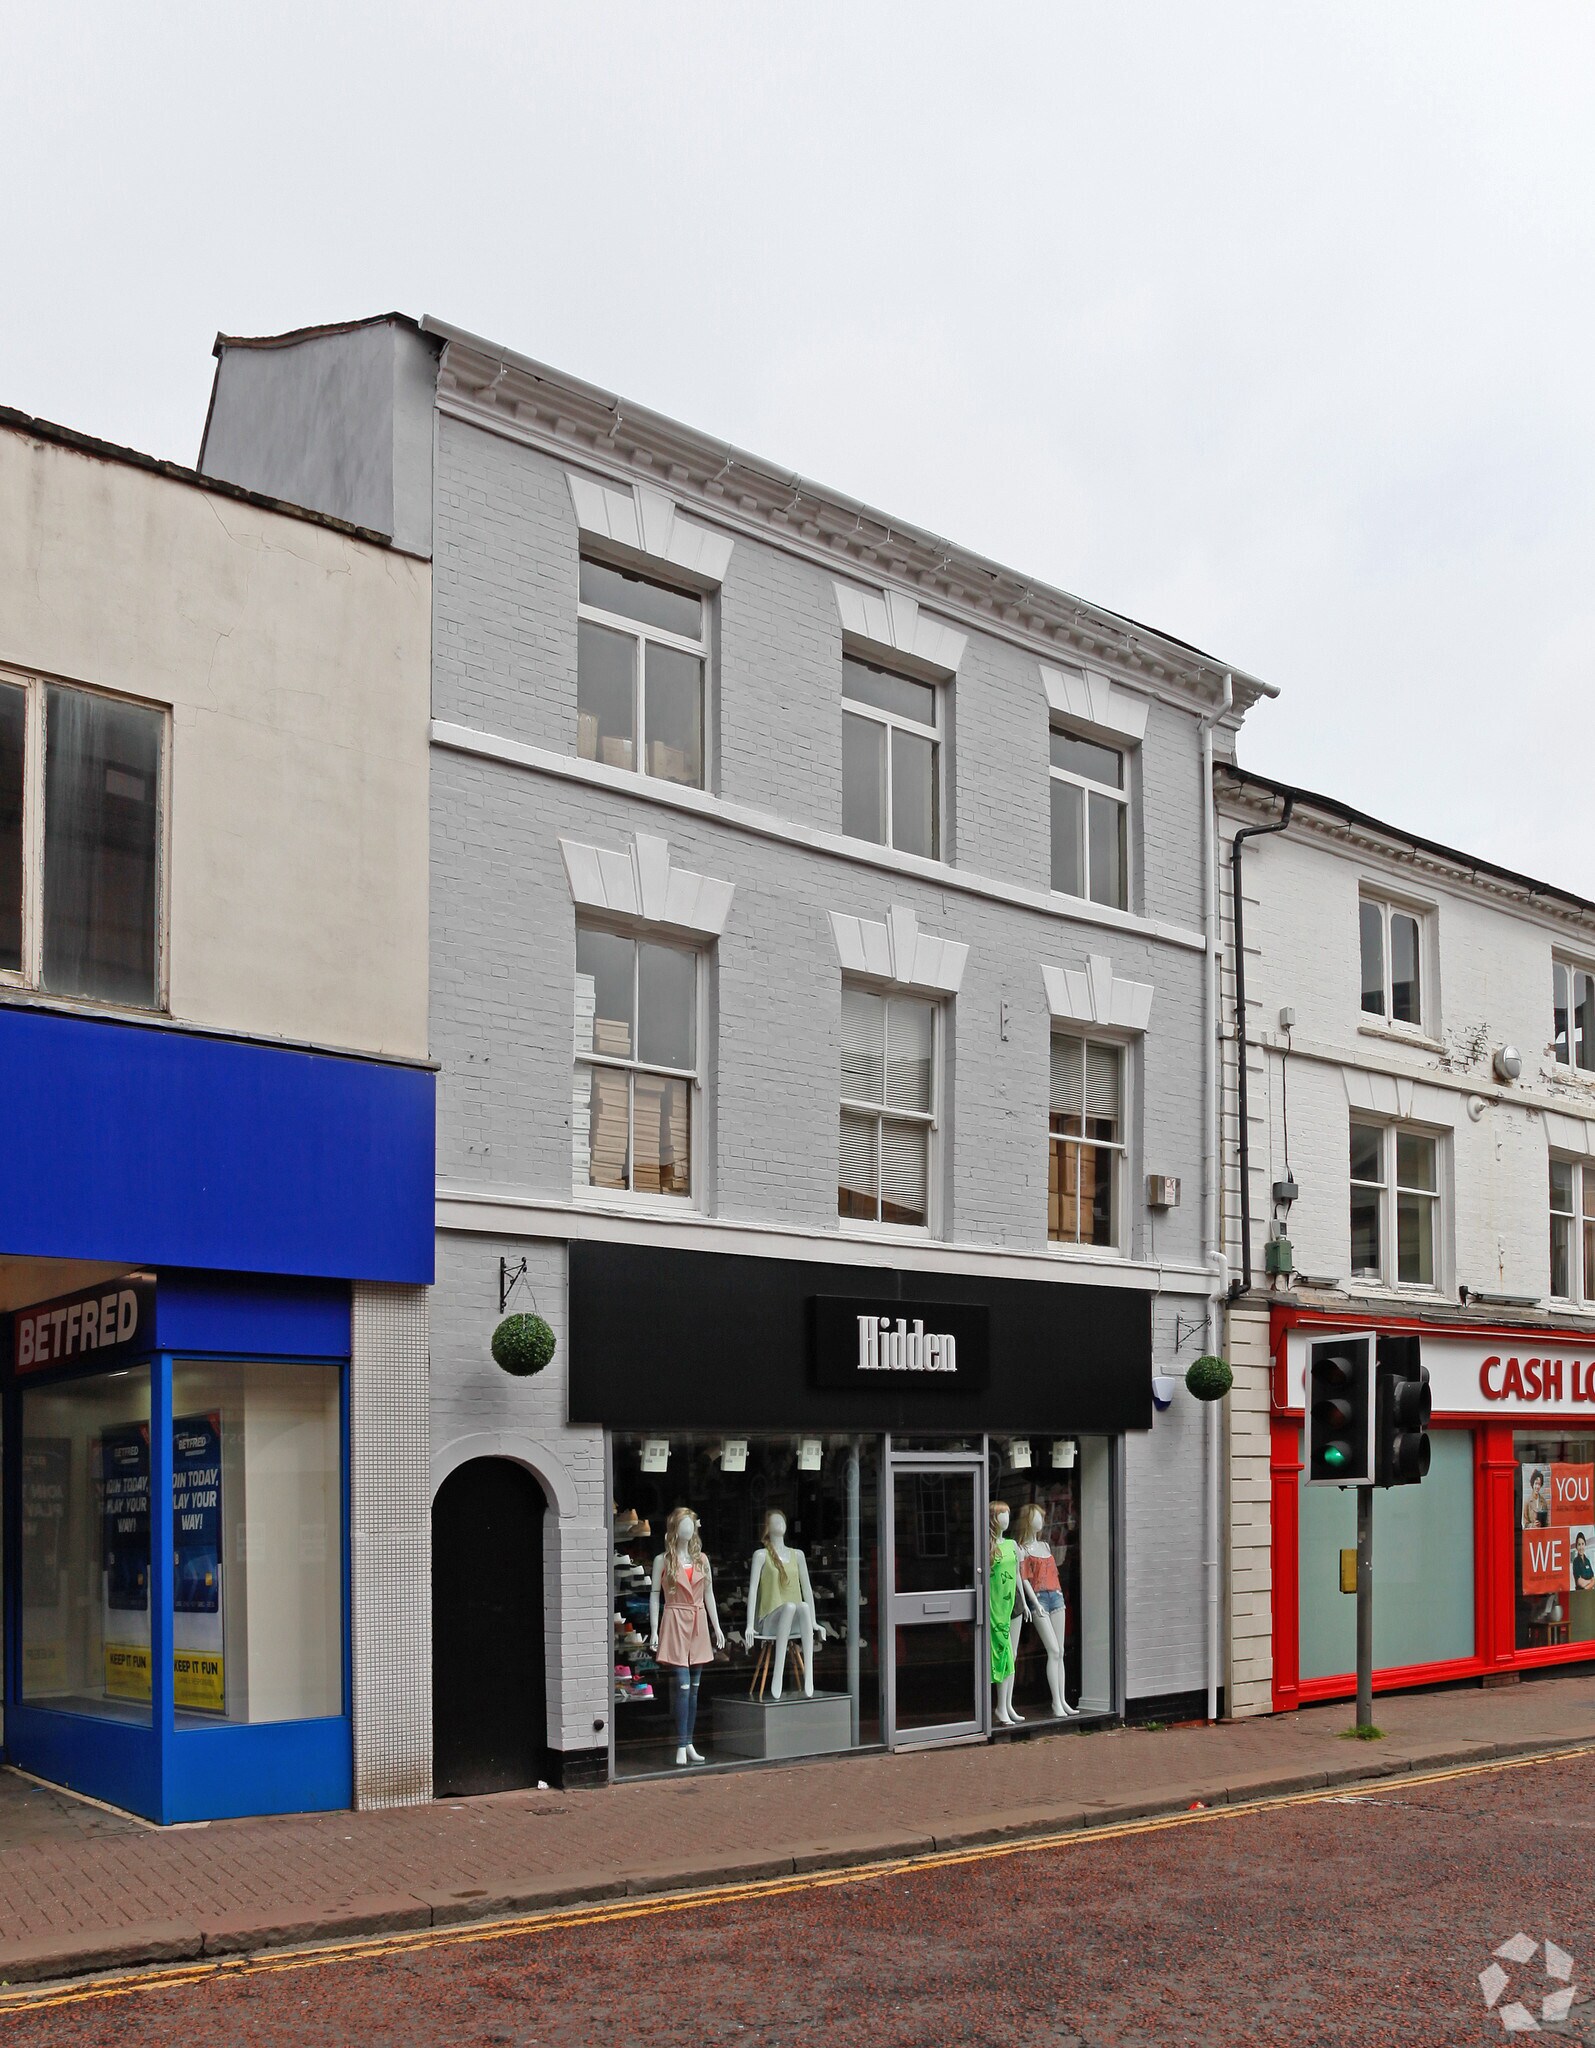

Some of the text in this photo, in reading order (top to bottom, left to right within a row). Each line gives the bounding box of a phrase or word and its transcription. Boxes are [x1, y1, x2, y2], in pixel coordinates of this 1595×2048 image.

[18, 1289, 138, 1366] BETFRED
[857, 1315, 958, 1372] Hidden
[1479, 1355, 1563, 1401] CASH
[178, 1436, 206, 1450] BETFRED
[172, 1469, 219, 1489] OIN TODAY,
[1555, 1476, 1590, 1502] YOU
[172, 1490, 217, 1510] LAY YOUR
[181, 1513, 204, 1531] WAY!
[1529, 1539, 1563, 1574] WE
[110, 1653, 126, 1665] KEEP
[132, 1656, 147, 1669] FUN
[192, 1661, 199, 1674] IT
[201, 1661, 218, 1675] FUN
